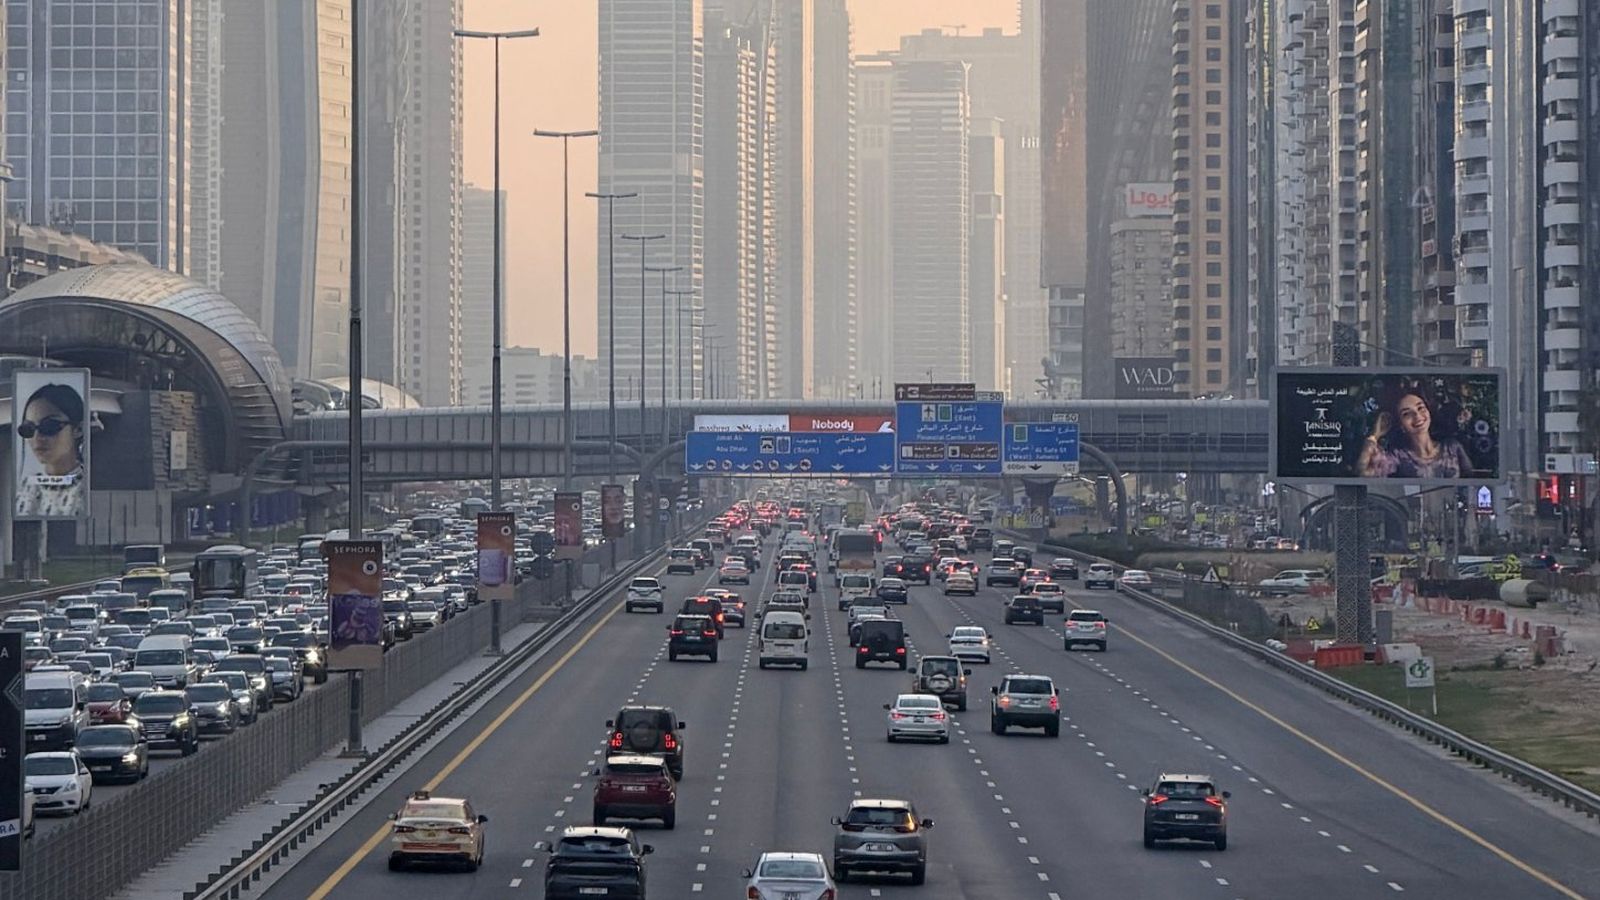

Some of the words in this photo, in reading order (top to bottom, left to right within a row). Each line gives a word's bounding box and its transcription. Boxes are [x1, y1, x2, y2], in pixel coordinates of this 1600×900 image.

[1121, 367, 1176, 385] WAD
[812, 418, 854, 432] Nobody
[1303, 420, 1342, 433] TANISHQ
[334, 546, 376, 555] SEPHORA
